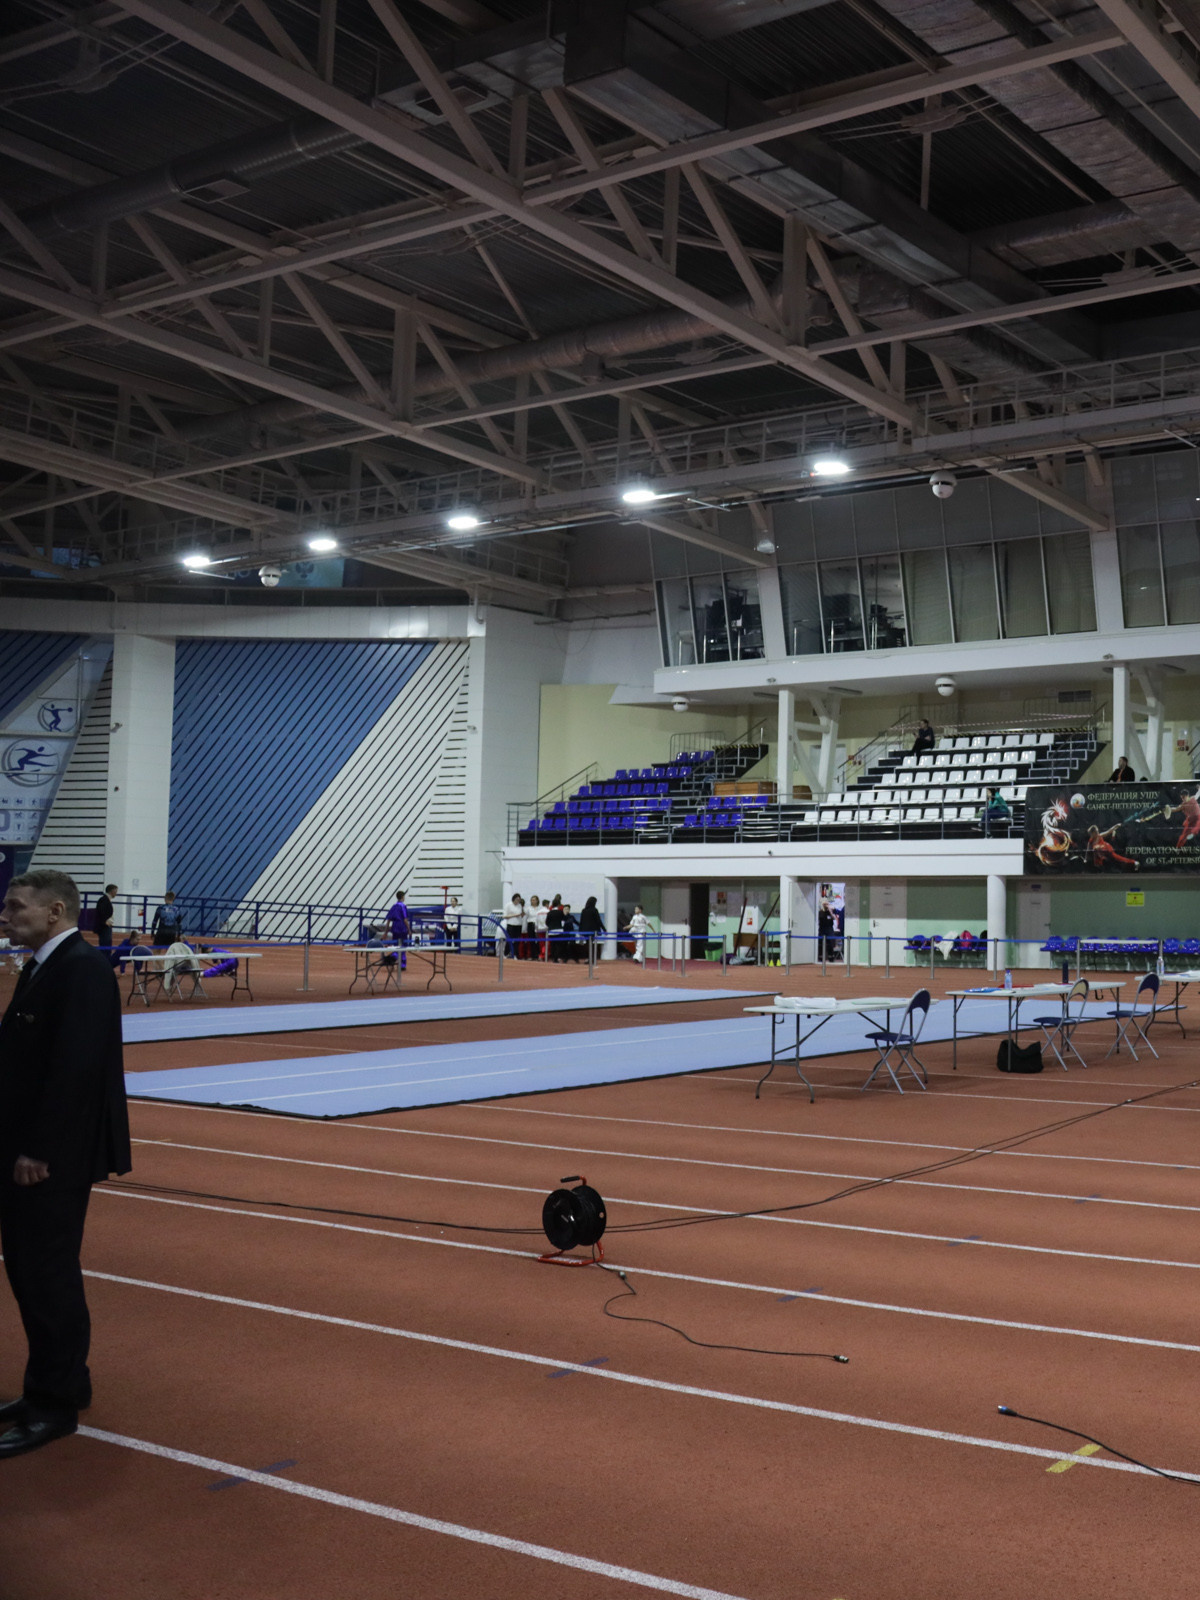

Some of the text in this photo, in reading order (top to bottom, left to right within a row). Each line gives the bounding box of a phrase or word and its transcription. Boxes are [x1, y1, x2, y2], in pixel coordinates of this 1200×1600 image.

[1087, 791, 1160, 801] ФЕДЕРАЦИЯ УШУ
[1086, 802, 1157, 811] САНКТ-ПЕТЕРБУРГА
[1125, 846, 1178, 855] FEDERATION
